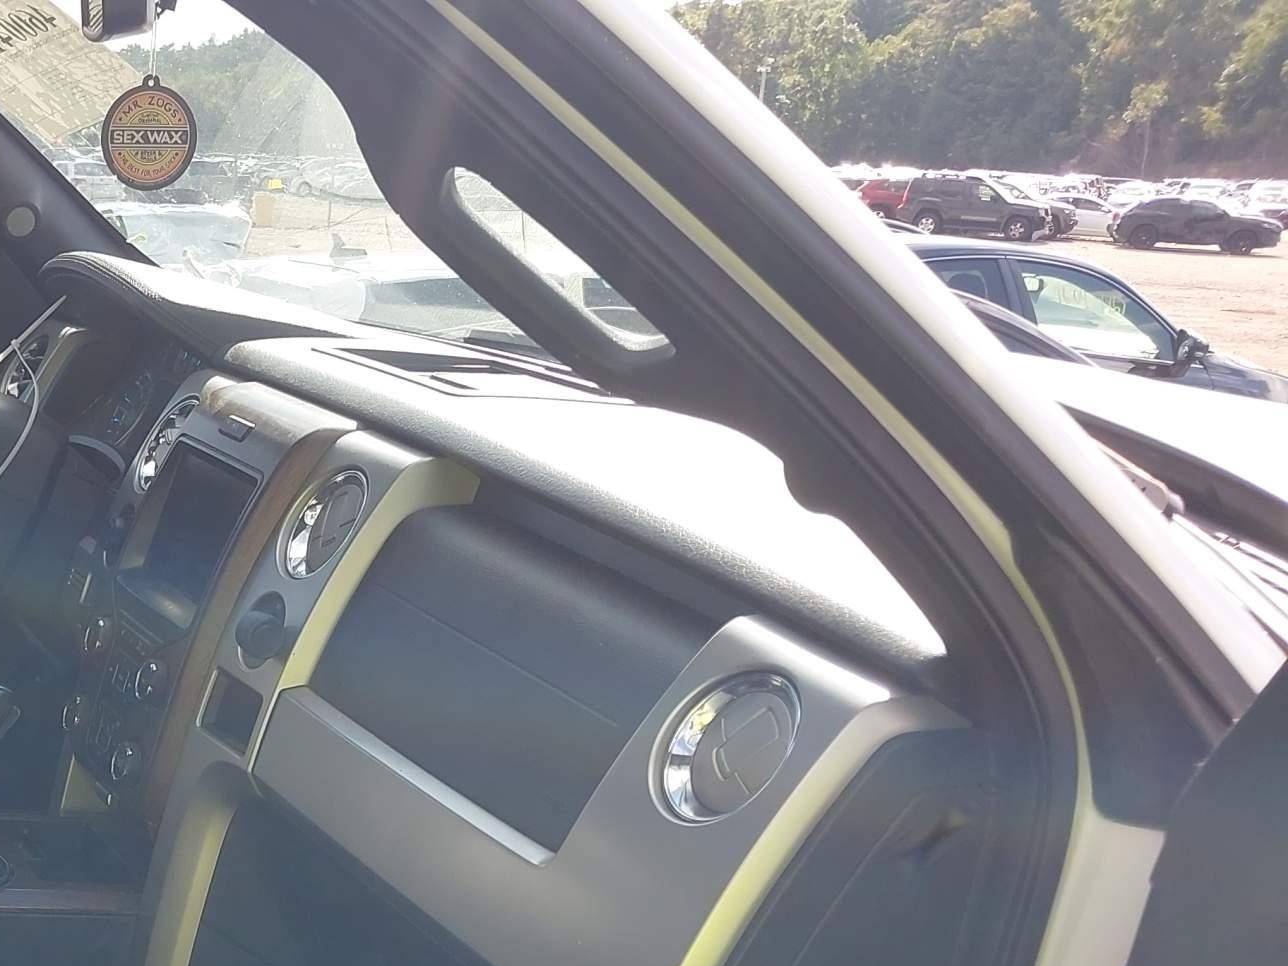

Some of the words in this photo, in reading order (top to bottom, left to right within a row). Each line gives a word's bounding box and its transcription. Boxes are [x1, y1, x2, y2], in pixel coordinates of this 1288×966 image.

[122, 100, 142, 117] MR
[148, 96, 179, 118] ZOGS
[113, 130, 145, 144] SEX
[147, 130, 183, 144] WAX
